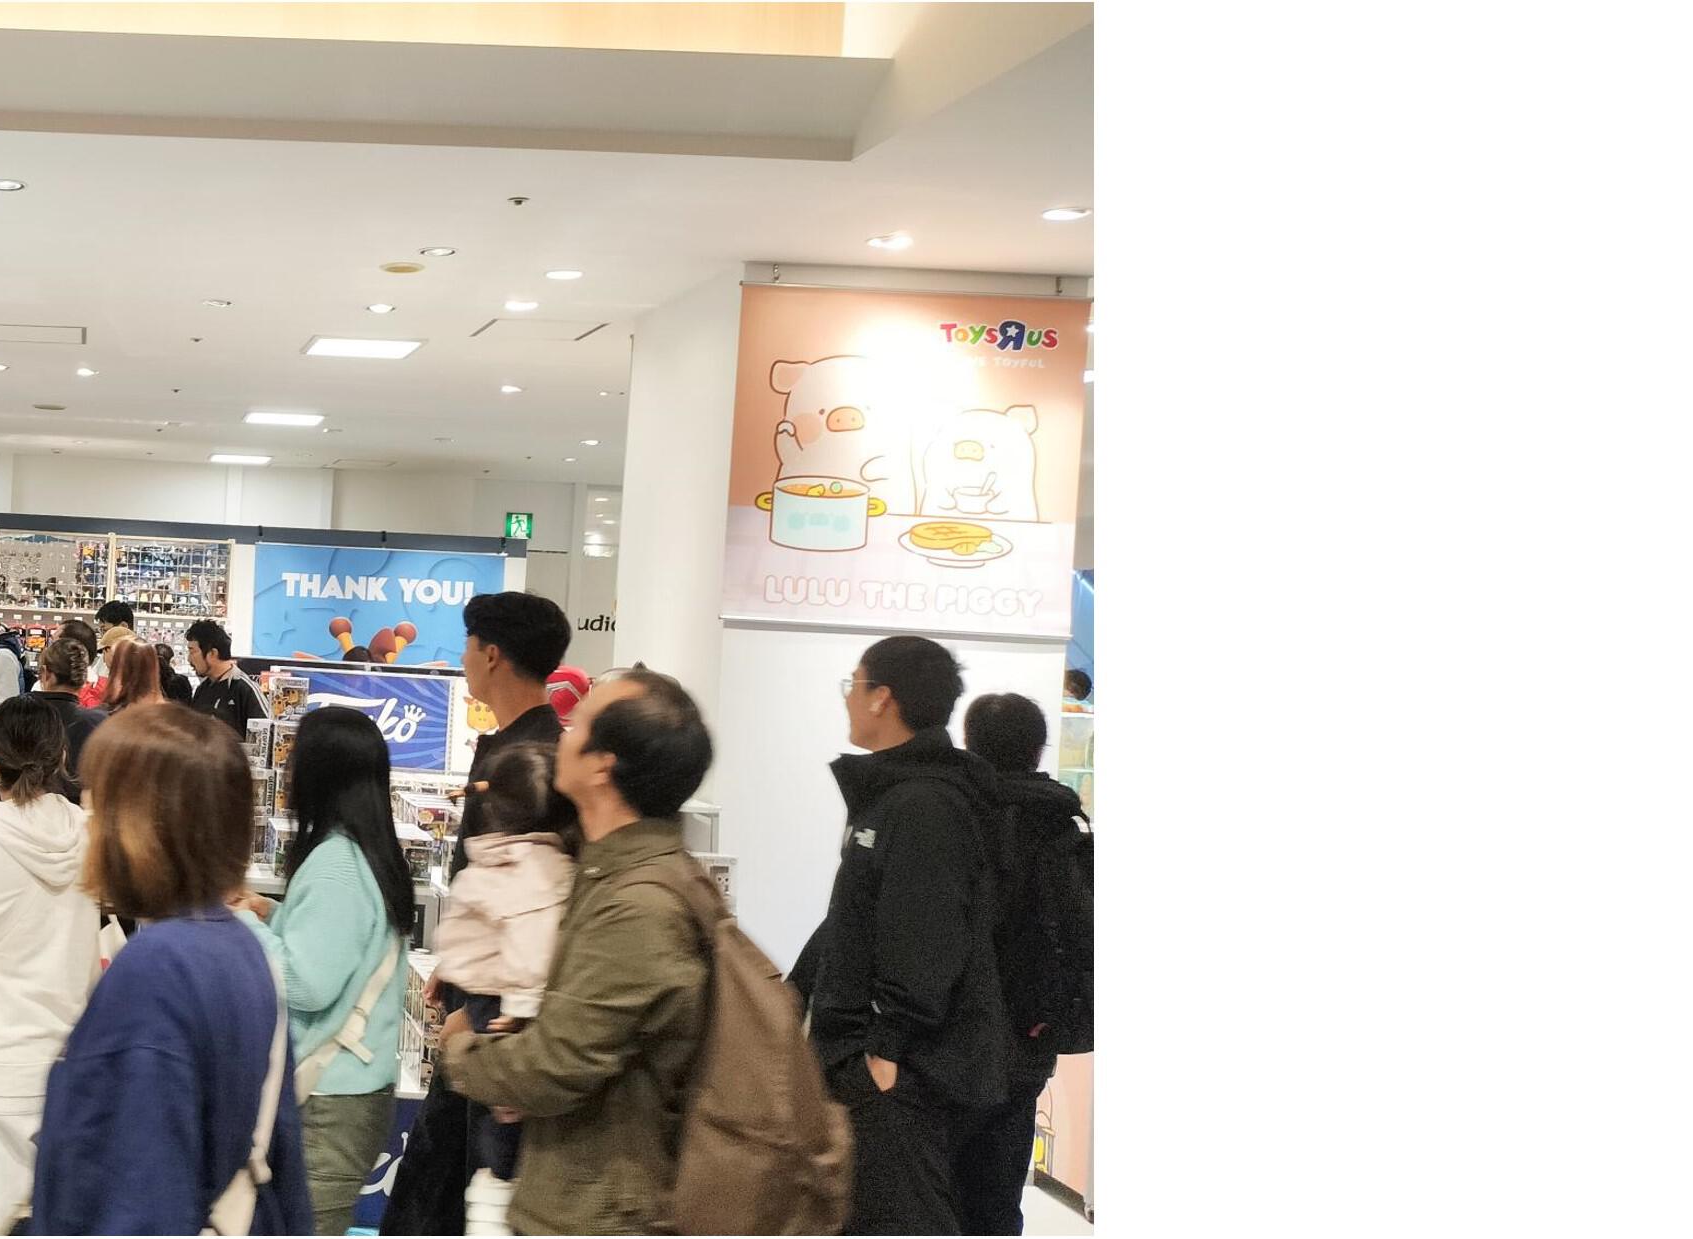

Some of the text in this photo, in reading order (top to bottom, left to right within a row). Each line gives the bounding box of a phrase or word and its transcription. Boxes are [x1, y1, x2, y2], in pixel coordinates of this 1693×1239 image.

[281, 572, 475, 606] THANK YOU!
[763, 574, 1043, 617] LULU THE PIGGY
